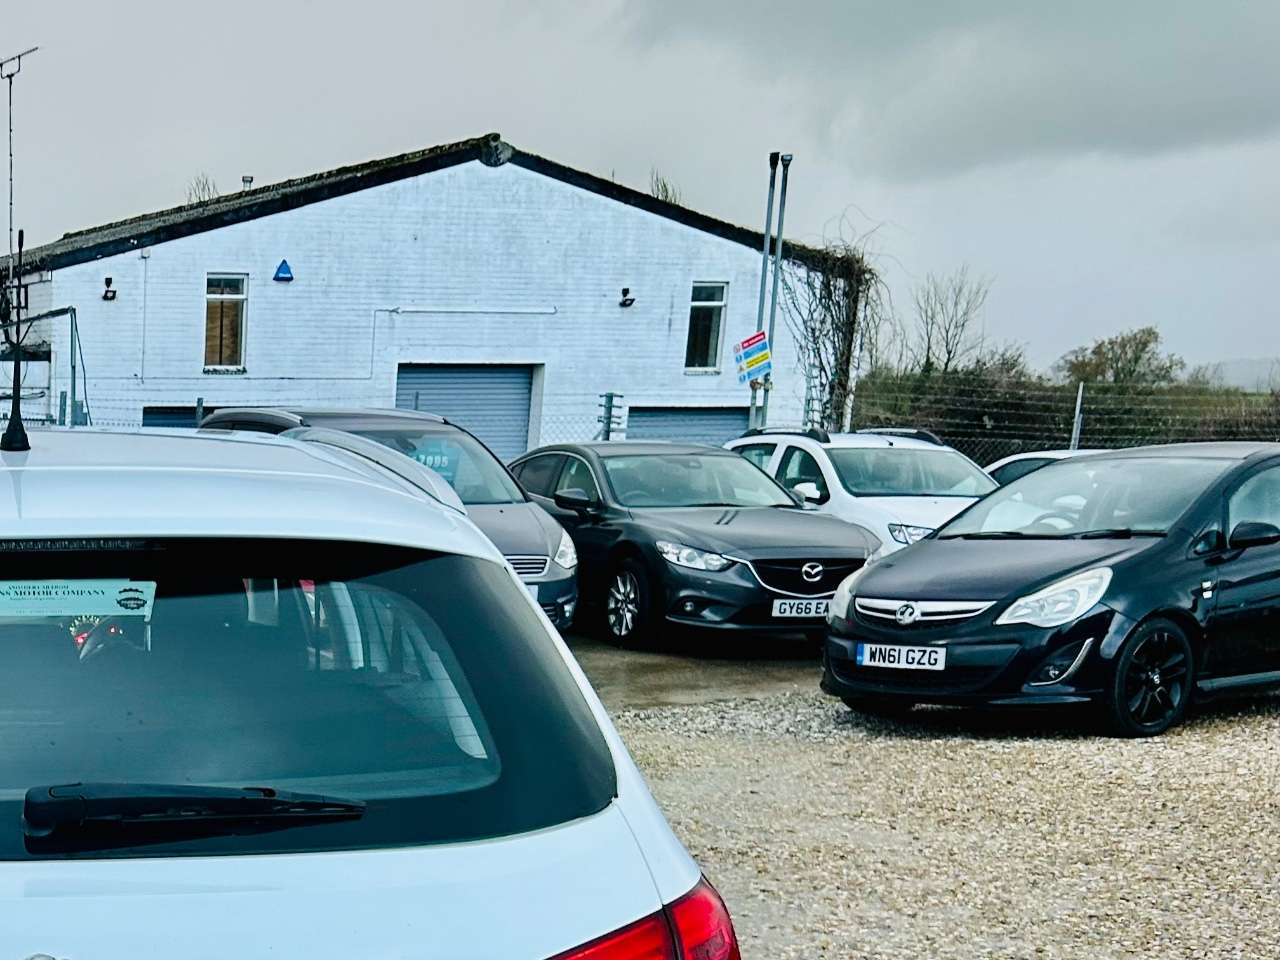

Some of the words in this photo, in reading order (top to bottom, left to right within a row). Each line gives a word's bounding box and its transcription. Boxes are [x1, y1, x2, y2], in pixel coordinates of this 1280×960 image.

[778, 602, 812, 615] GY66
[815, 602, 829, 615] EA
[869, 646, 900, 664] WN61
[905, 649, 938, 666] GZG
